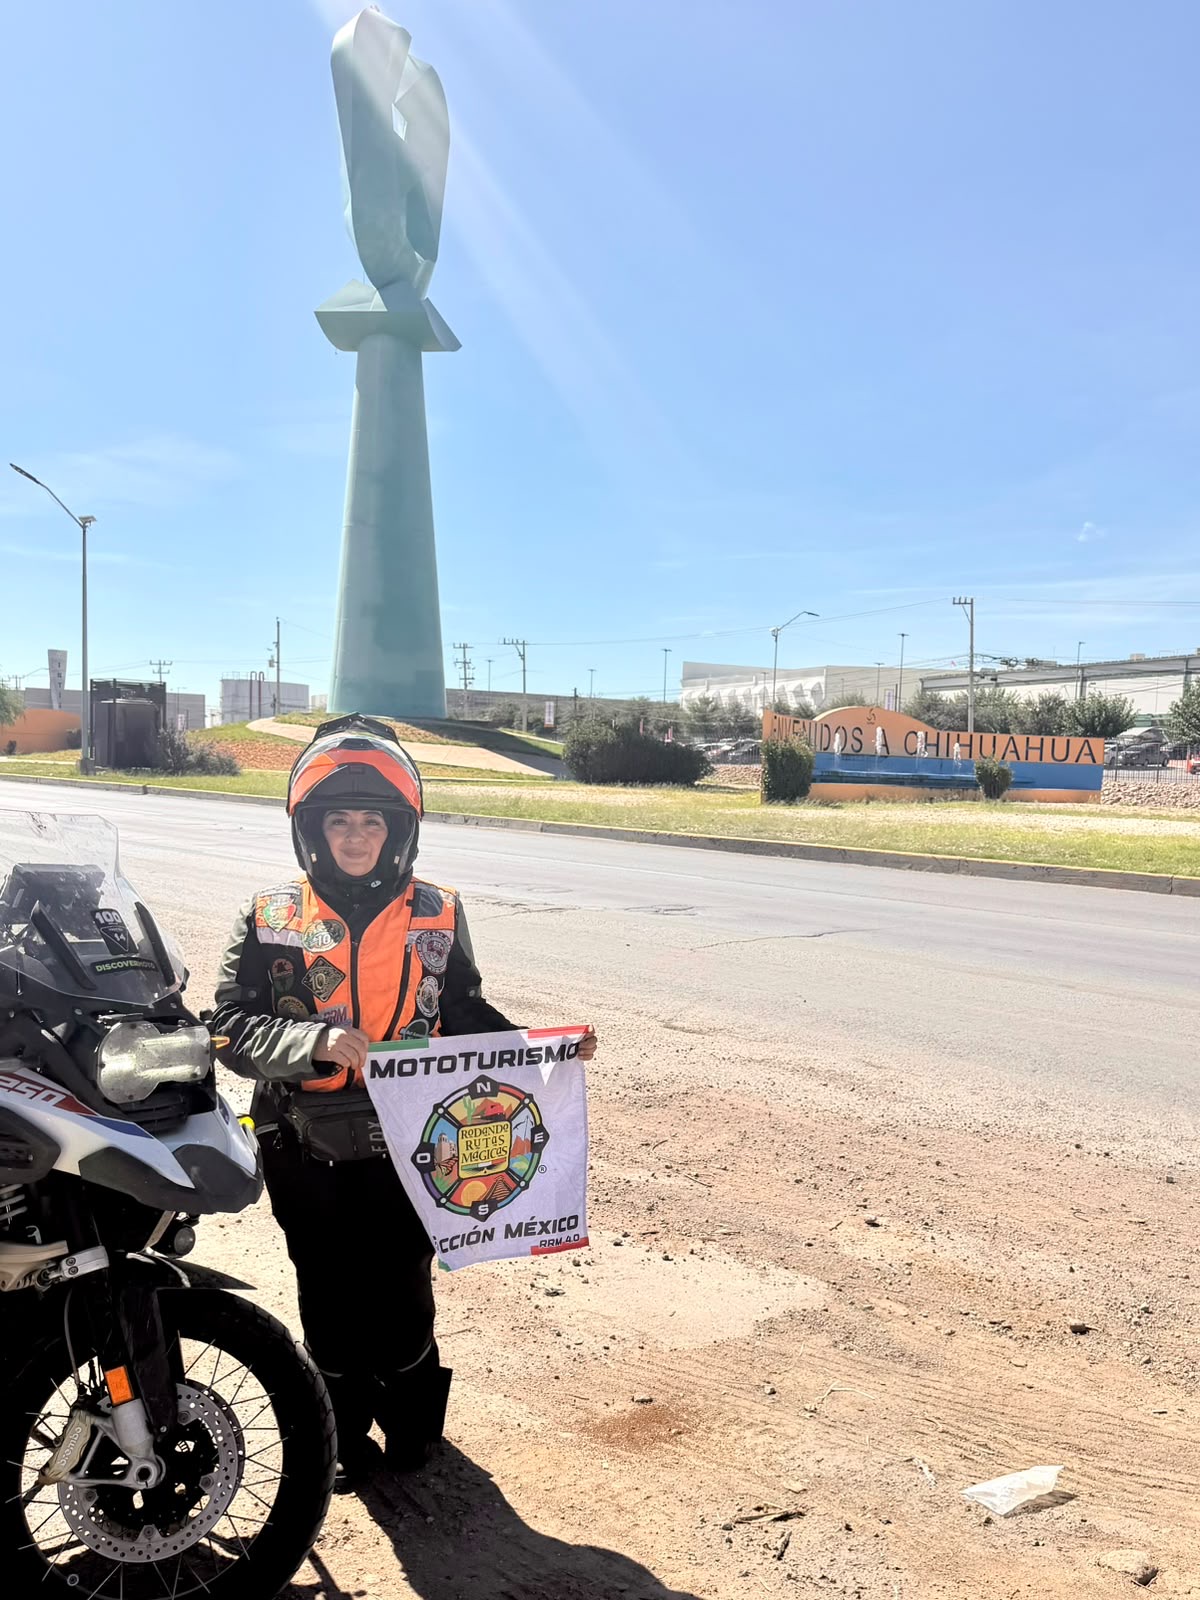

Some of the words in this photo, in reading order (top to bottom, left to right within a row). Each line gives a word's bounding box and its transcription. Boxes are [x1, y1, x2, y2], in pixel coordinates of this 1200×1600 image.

[904, 730, 1097, 764] CHIHUAHUA
[95, 911, 122, 924] 100
[370, 1042, 580, 1079] MOTOTURISMO
[476, 1081, 491, 1093] N
[534, 1131, 544, 1143] E
[416, 1152, 431, 1164] O
[478, 1204, 489, 1216] S
[504, 1215, 580, 1240] MÉXICO
[57, 1426, 82, 1467] brembo
